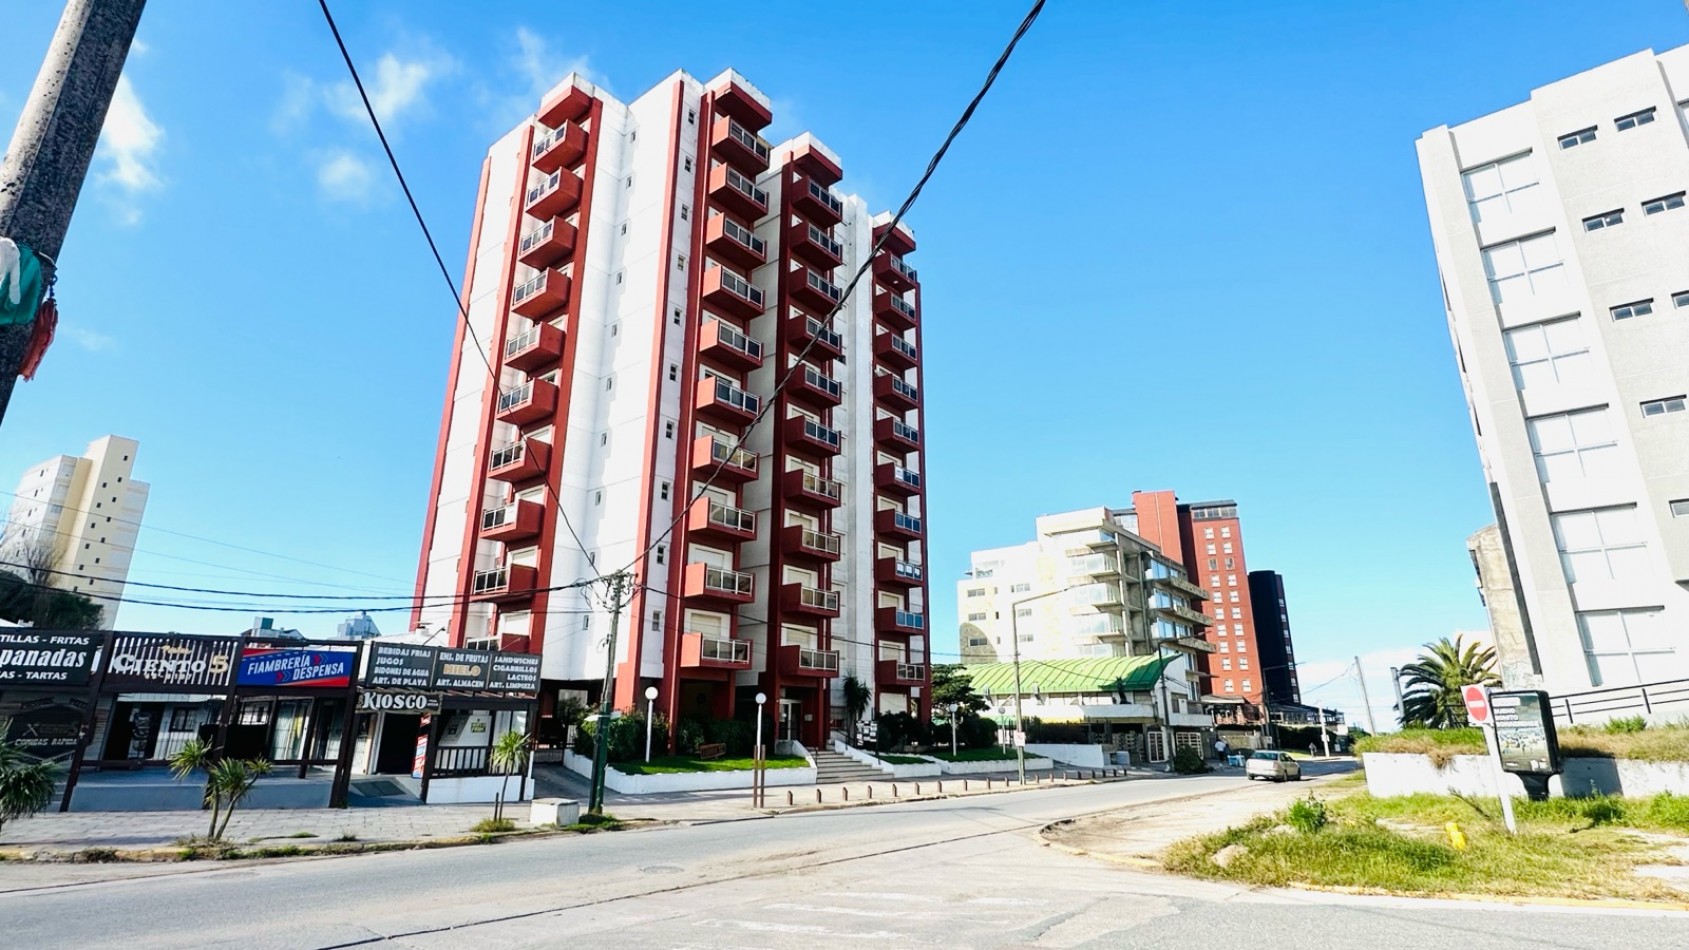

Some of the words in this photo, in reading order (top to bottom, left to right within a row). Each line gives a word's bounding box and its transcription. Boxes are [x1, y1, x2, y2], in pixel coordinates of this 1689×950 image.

[0, 634, 40, 644] TILLAS
[49, 636, 90, 645] FRITAS
[378, 647, 409, 656] BEBIDAS
[411, 649, 431, 657] FRIAS
[0, 648, 87, 668] panadas
[112, 653, 207, 673] CIENTO
[209, 655, 229, 673] 5
[376, 657, 404, 665] JUGOS
[455, 653, 465, 661] DE
[466, 654, 489, 663] FRUTAS
[494, 656, 538, 665] SANDWICHES
[247, 654, 311, 675] FIAMBRERÍA
[493, 665, 538, 673] CIGARRILLOS
[292, 662, 344, 681] DESPENSA
[374, 666, 401, 674] BIDONES
[0, 671, 16, 679] AS
[25, 671, 68, 680] TARTAS
[372, 676, 390, 685] ART.
[391, 677, 402, 685] DE
[403, 678, 427, 686] PLAYA
[436, 678, 451, 686] ART.
[453, 679, 484, 688] ALMACEN
[361, 691, 427, 710] KIOSCO
